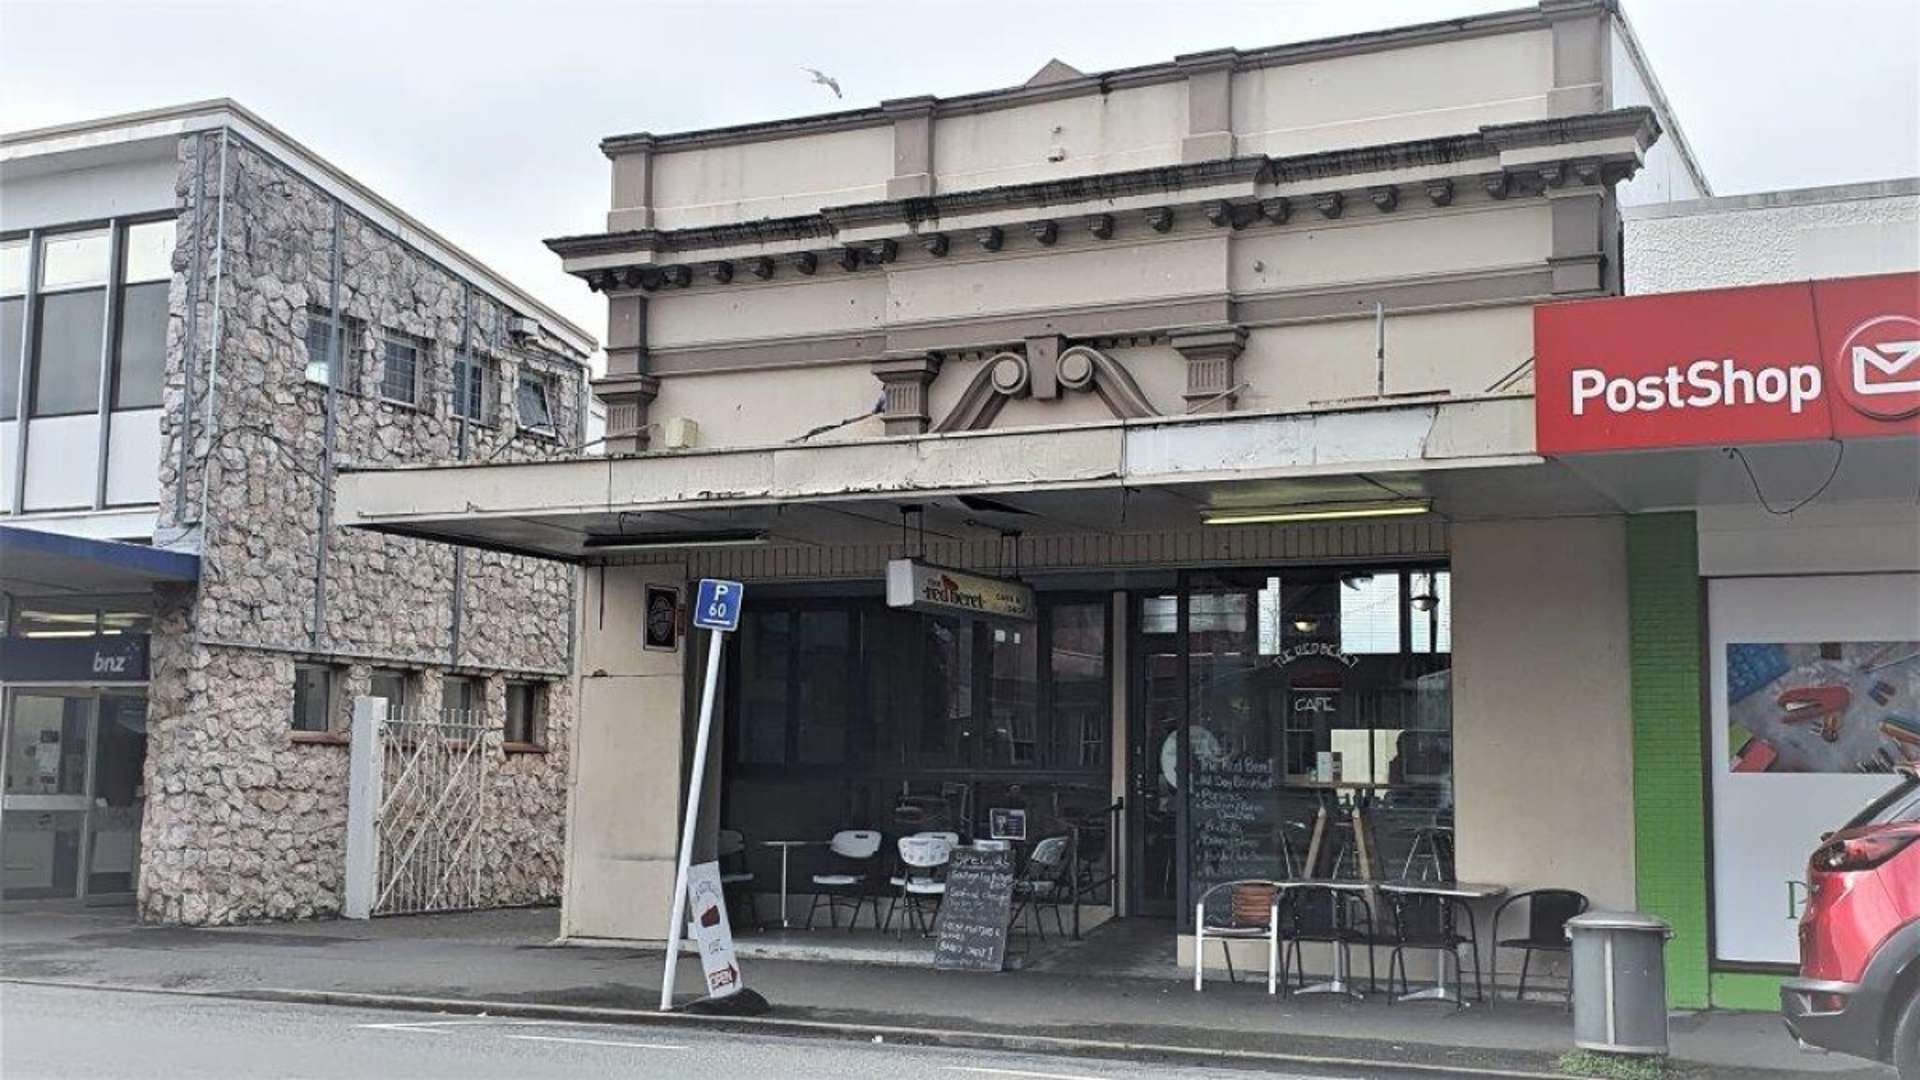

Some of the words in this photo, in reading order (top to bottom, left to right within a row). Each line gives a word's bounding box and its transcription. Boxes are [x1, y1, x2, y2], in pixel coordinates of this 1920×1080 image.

[1571, 359, 1822, 415] PostShop
[714, 584, 729, 601] P
[708, 602, 727, 618] 60
[93, 651, 127, 672] bnz
[1295, 696, 1337, 712] CAFE
